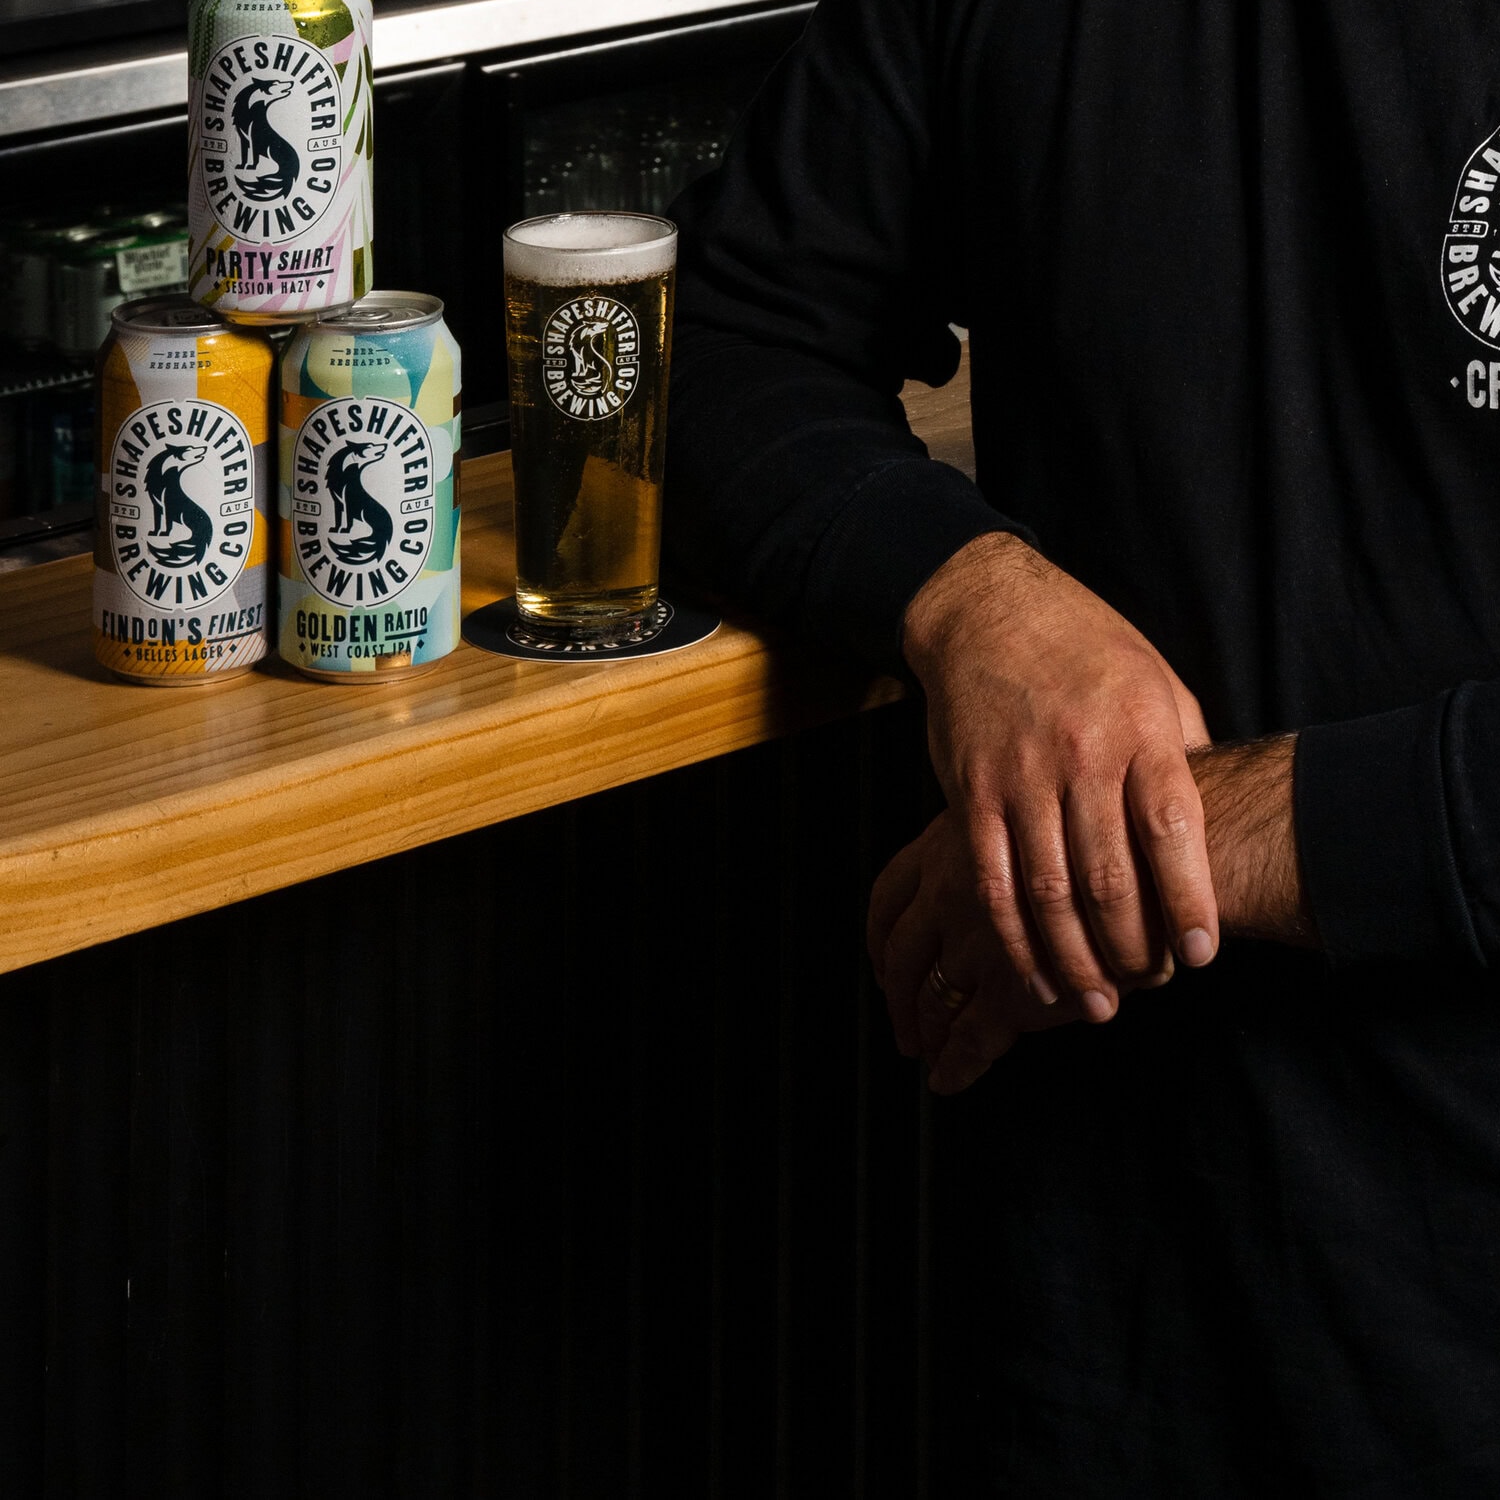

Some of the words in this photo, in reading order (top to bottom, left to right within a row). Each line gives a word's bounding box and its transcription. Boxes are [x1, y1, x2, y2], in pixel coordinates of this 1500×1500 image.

[236, 2, 298, 11] RESHAPED
[205, 41, 337, 133] SHAPESHIFTER
[313, 139, 338, 149] AUS
[206, 159, 316, 237] BREWING
[307, 156, 336, 194] CO
[1452, 224, 1482, 234] STH
[206, 247, 273, 280] PARTY
[277, 246, 334, 271] SHIRT
[225, 281, 273, 295] SESSION
[281, 280, 311, 294] HAZY
[547, 300, 636, 355] SHAPESHIFTER
[166, 350, 196, 359] BEER
[345, 347, 375, 356] BEER
[149, 360, 213, 369] RESHAPED
[329, 357, 391, 367] RESHAPED
[547, 370, 622, 417] BREWING
[615, 367, 635, 391] CO
[115, 406, 248, 498] SHAPESHIFTER
[297, 403, 429, 495] SHAPESHIFTER
[225, 502, 249, 513] AUS
[406, 499, 430, 511] AUS
[115, 525, 228, 604] BREWING
[219, 521, 247, 558] CO
[297, 522, 408, 600] BREWING
[400, 518, 427, 555] CO
[102, 609, 203, 647] FINDON'S
[208, 603, 263, 636] FINEST
[296, 610, 378, 643] GOLDEN
[384, 606, 428, 633] RATIO
[136, 648, 178, 662] HELLES
[184, 645, 223, 661] LAGER
[310, 643, 339, 658] WEST
[347, 643, 385, 659] COAST
[393, 640, 411, 656] IPA
